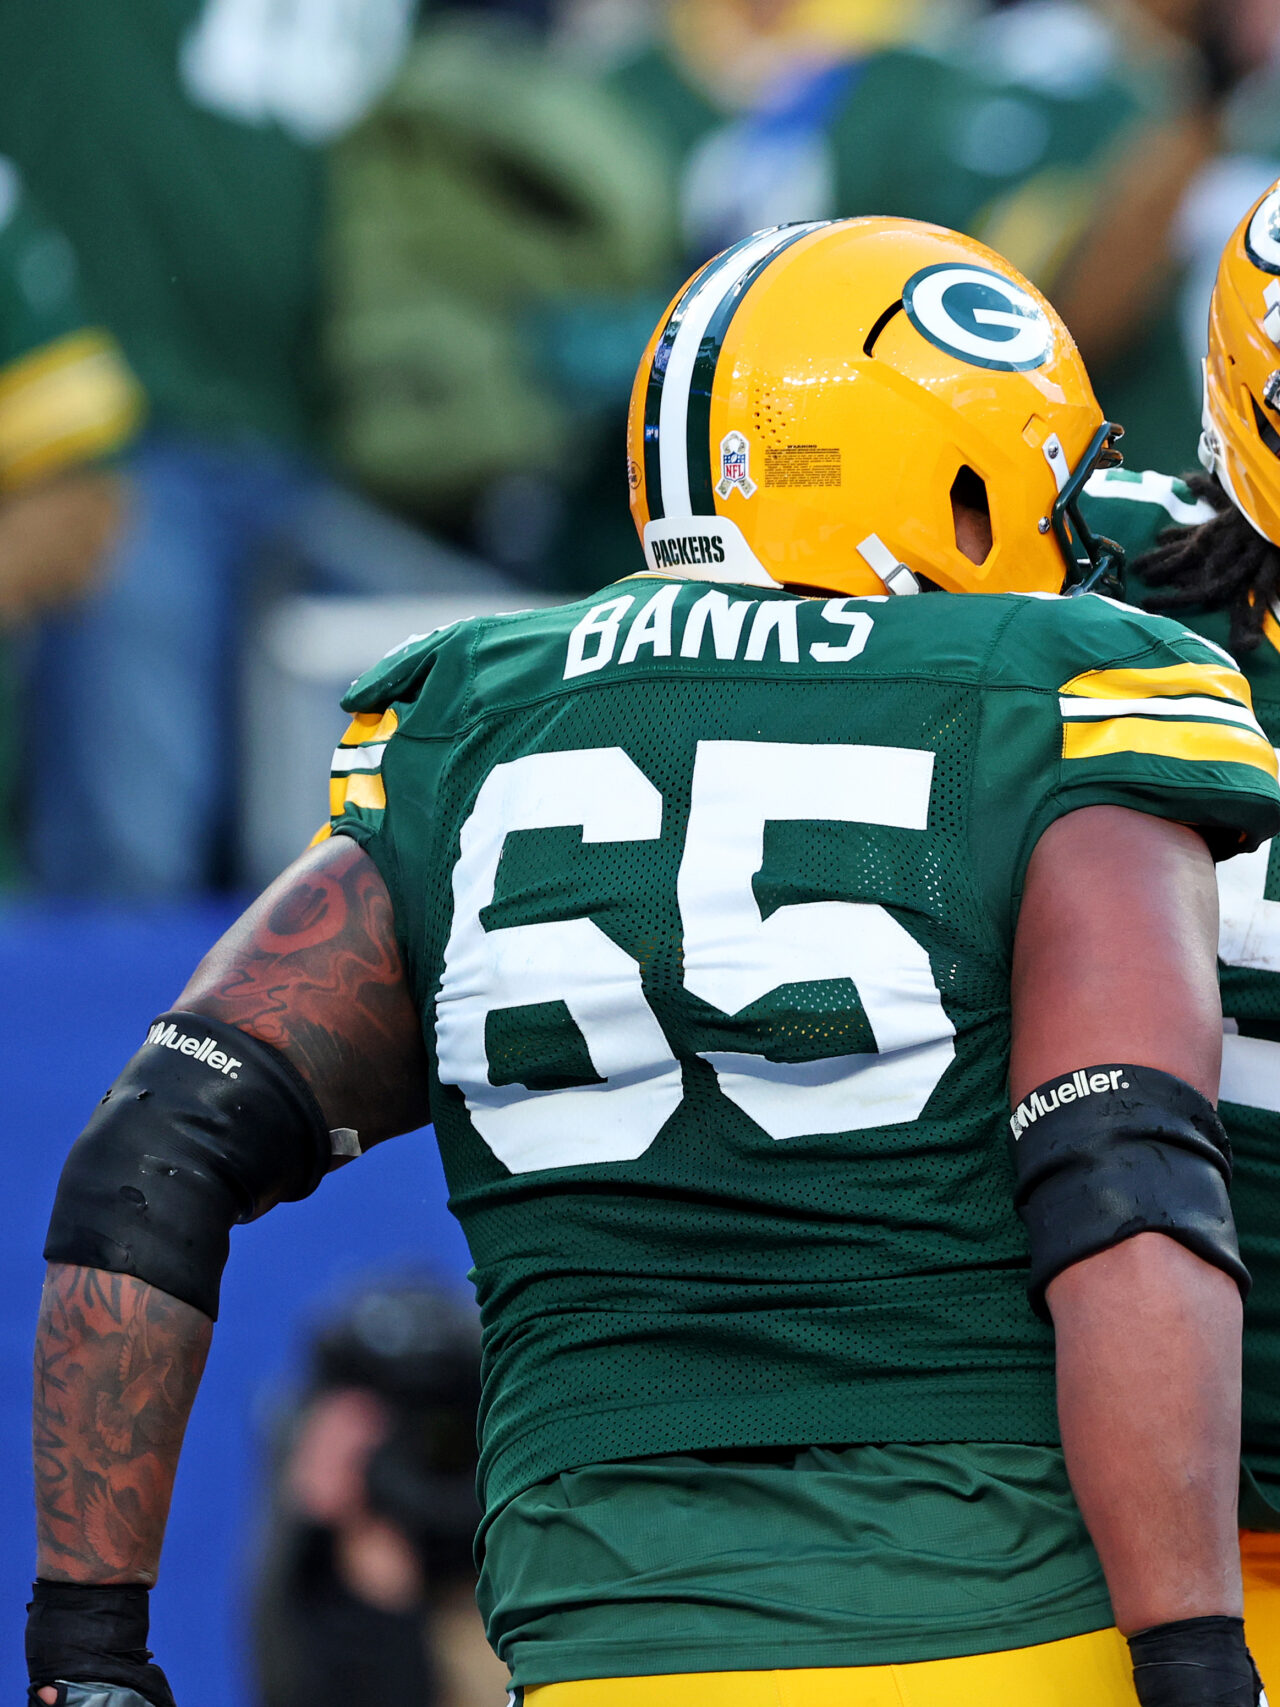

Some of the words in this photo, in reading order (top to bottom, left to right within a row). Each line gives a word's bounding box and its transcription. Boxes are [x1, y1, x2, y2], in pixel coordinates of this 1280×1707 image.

[726, 464, 744, 479] NFL
[651, 535, 725, 568] PACKERS
[562, 584, 889, 680] BANKS
[435, 740, 957, 1174] 65
